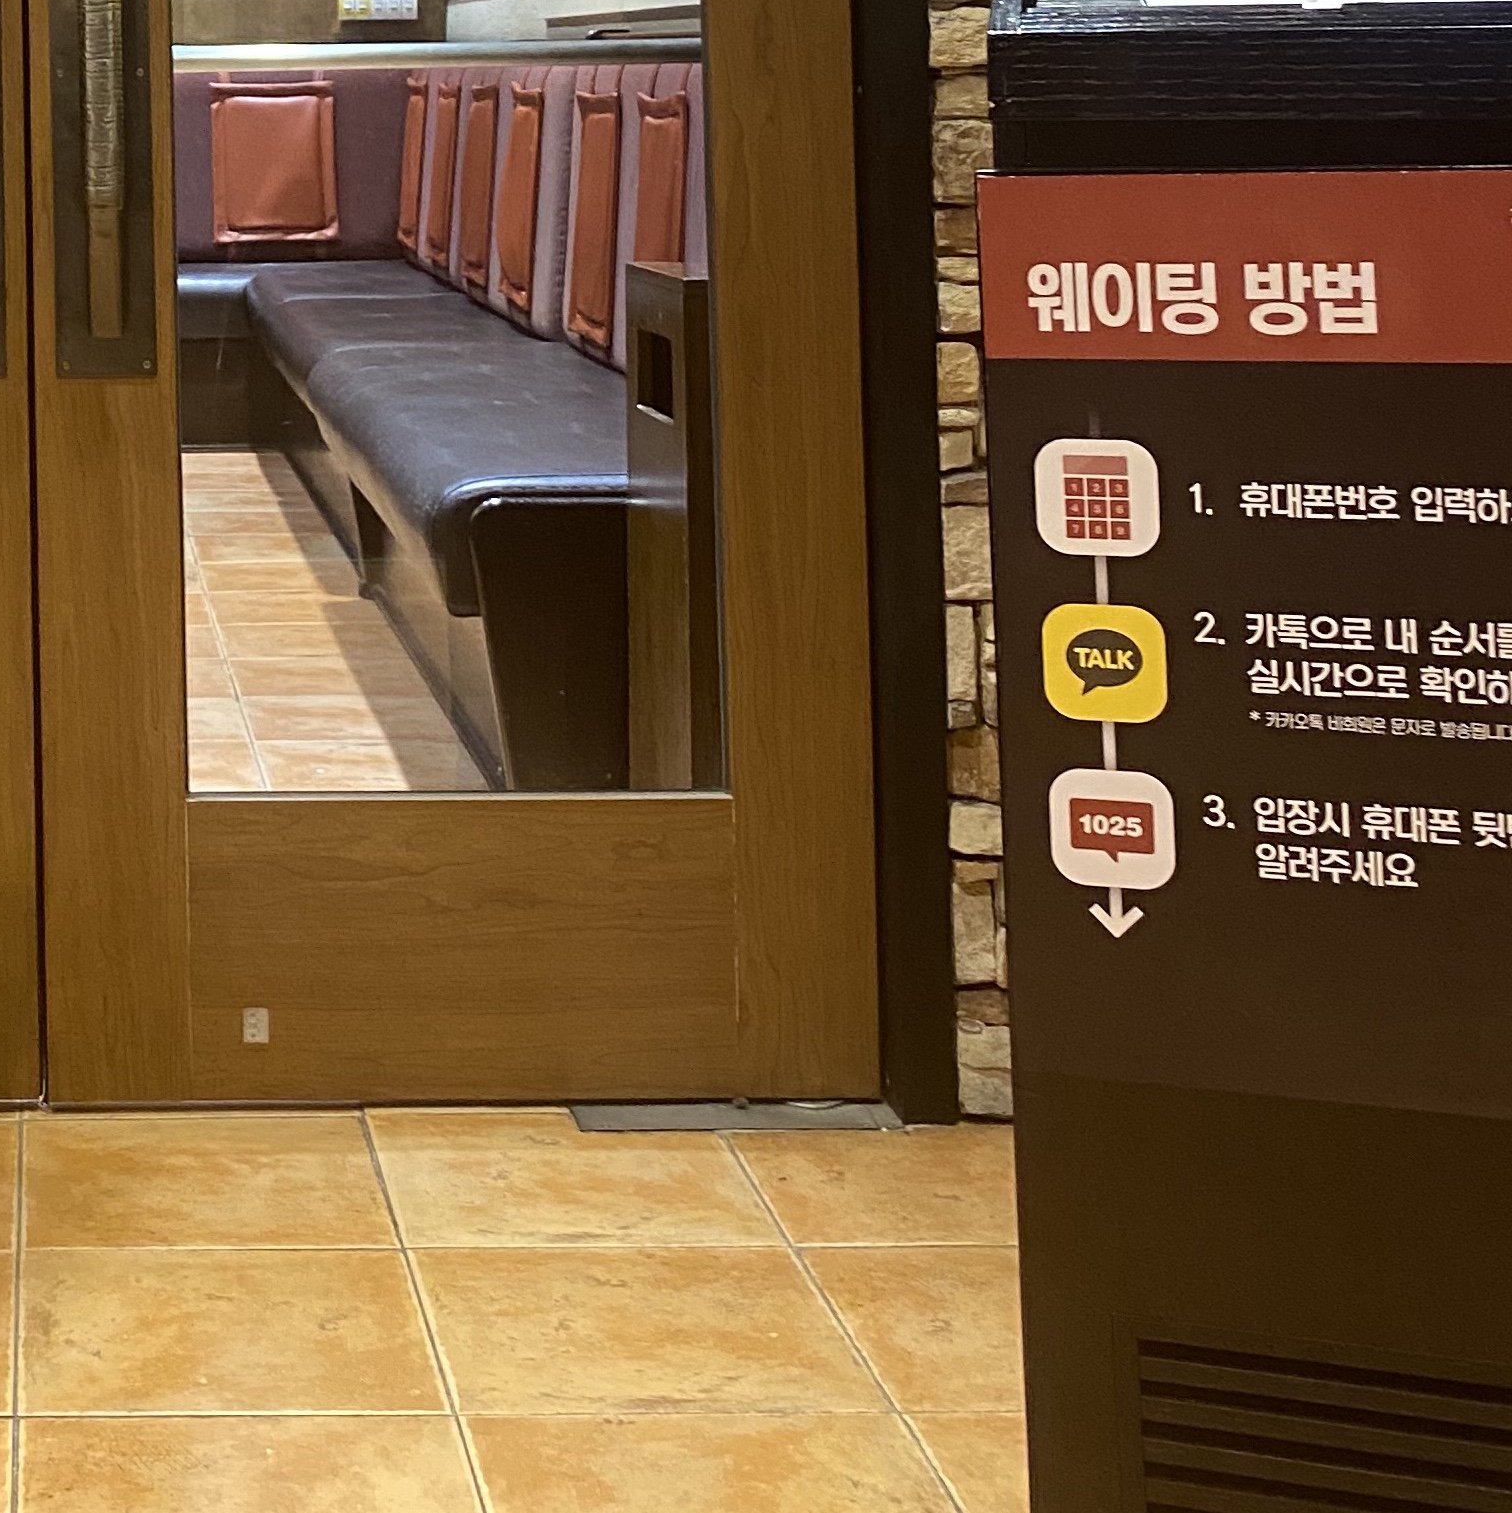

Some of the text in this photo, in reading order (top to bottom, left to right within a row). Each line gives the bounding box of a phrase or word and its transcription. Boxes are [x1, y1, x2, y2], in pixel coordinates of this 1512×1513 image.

[1026, 261, 1379, 335] 웨이팅 방법
[1189, 482, 1512, 524] 1. 휴대폰번호 입력하
[1193, 611, 1226, 645] 2.
[1245, 613, 1375, 650] 카톡으로
[1384, 618, 1419, 654] 내
[1072, 647, 1135, 670] TALK
[1246, 658, 1410, 699] 실시간으로
[1265, 710, 1324, 730] 카카오톡
[1327, 715, 1387, 735] 비회원은
[1391, 718, 1437, 737] 문자로
[1078, 813, 1144, 839] 1025
[1202, 794, 1512, 849] 3. 입장시 휴대폰 뒷
[1254, 843, 1419, 888] 알려주세요
